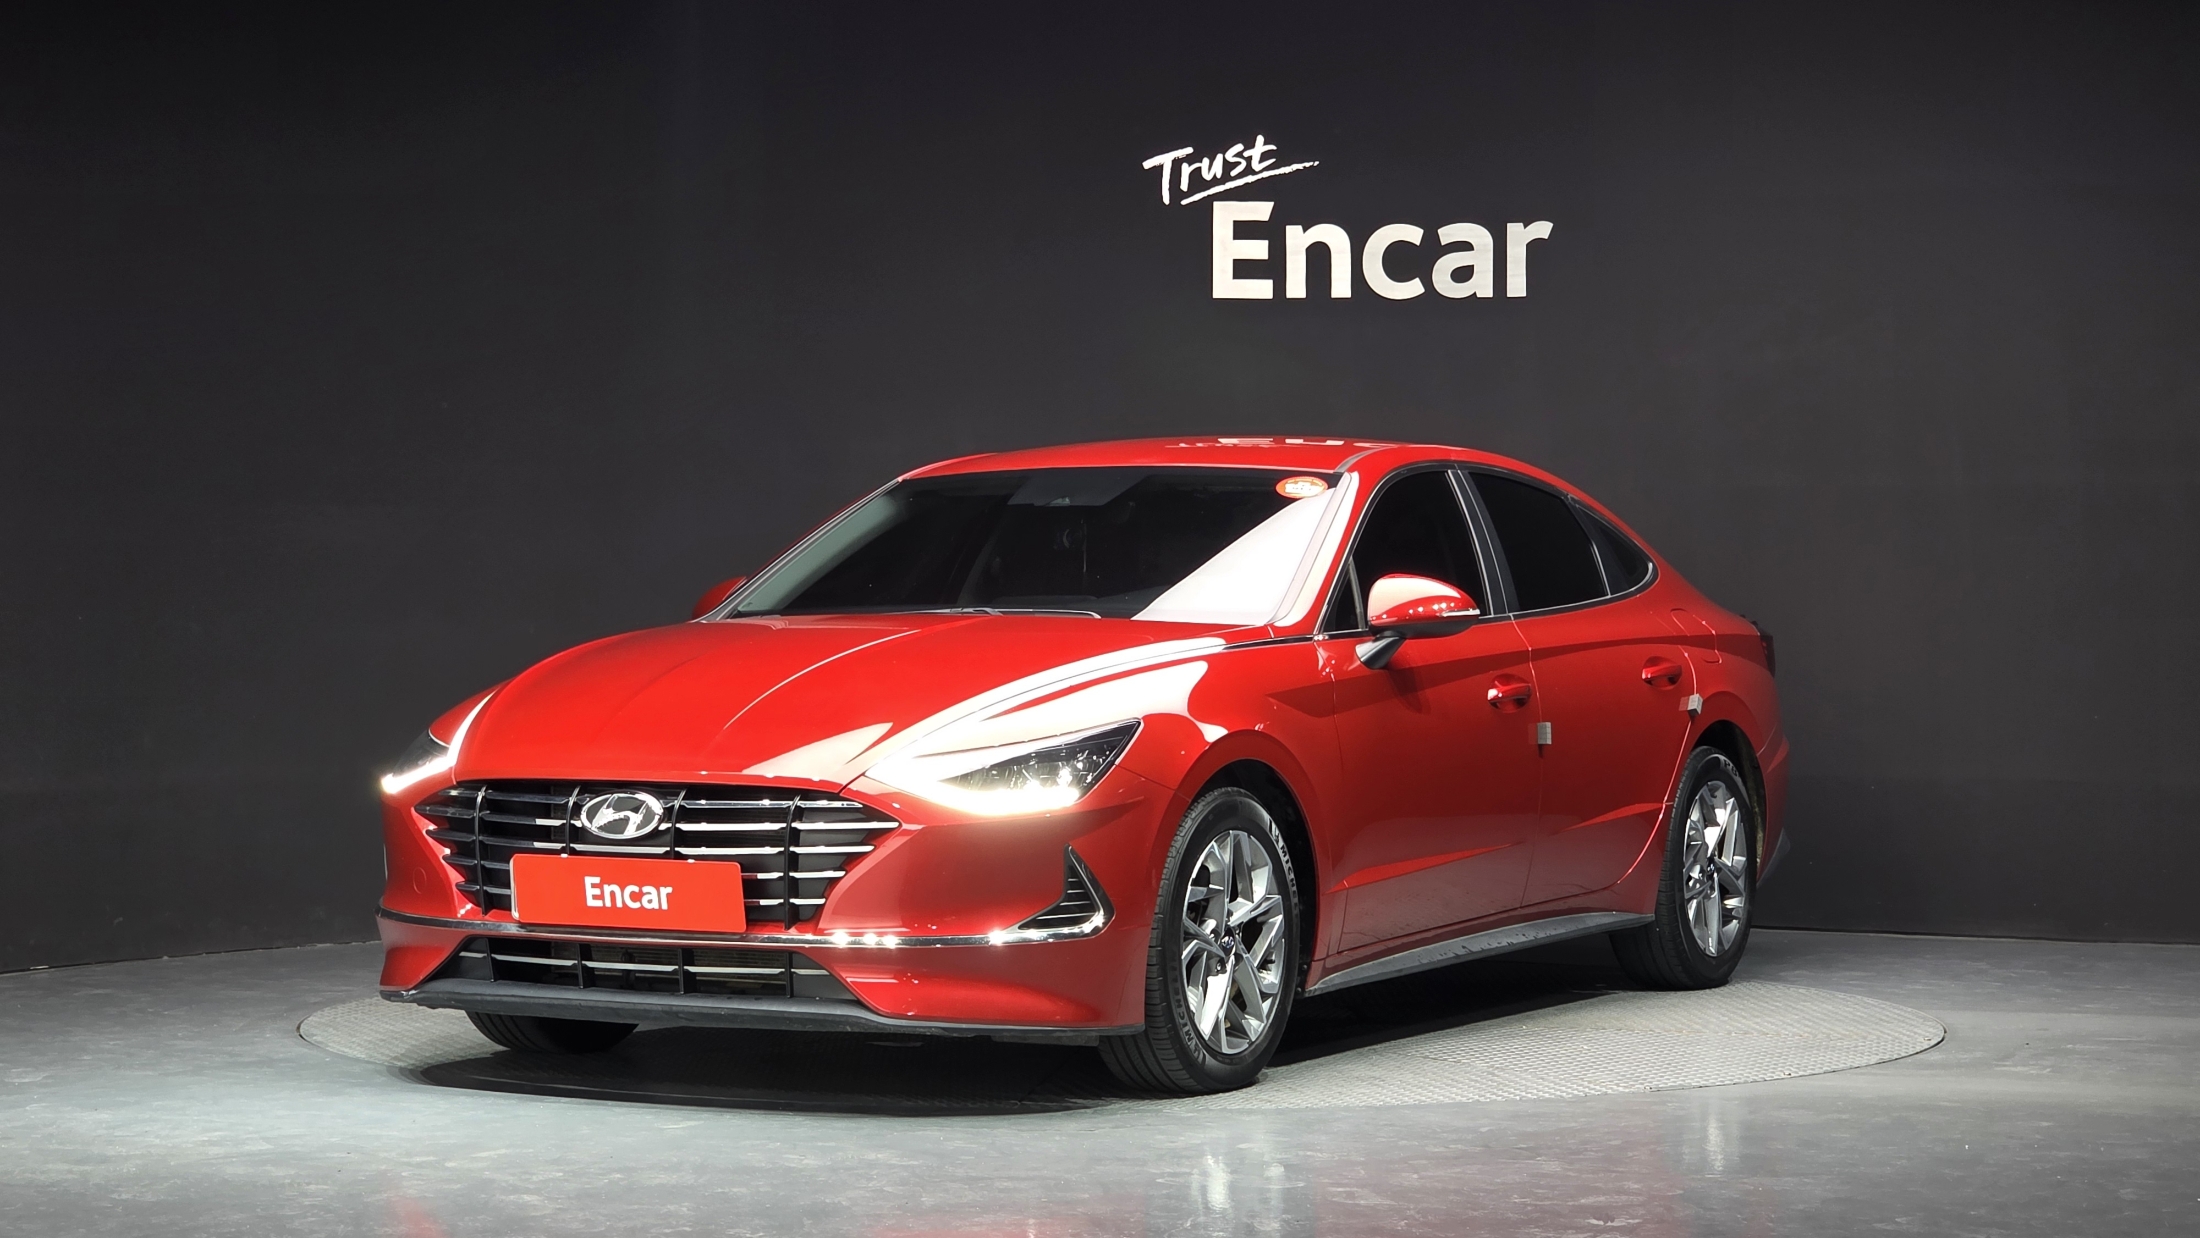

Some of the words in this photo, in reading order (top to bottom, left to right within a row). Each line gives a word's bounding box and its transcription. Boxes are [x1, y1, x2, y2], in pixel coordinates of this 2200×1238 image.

[1142, 134, 1278, 206] Trust
[1212, 200, 1554, 300] Encar
[584, 876, 673, 911] Encar
